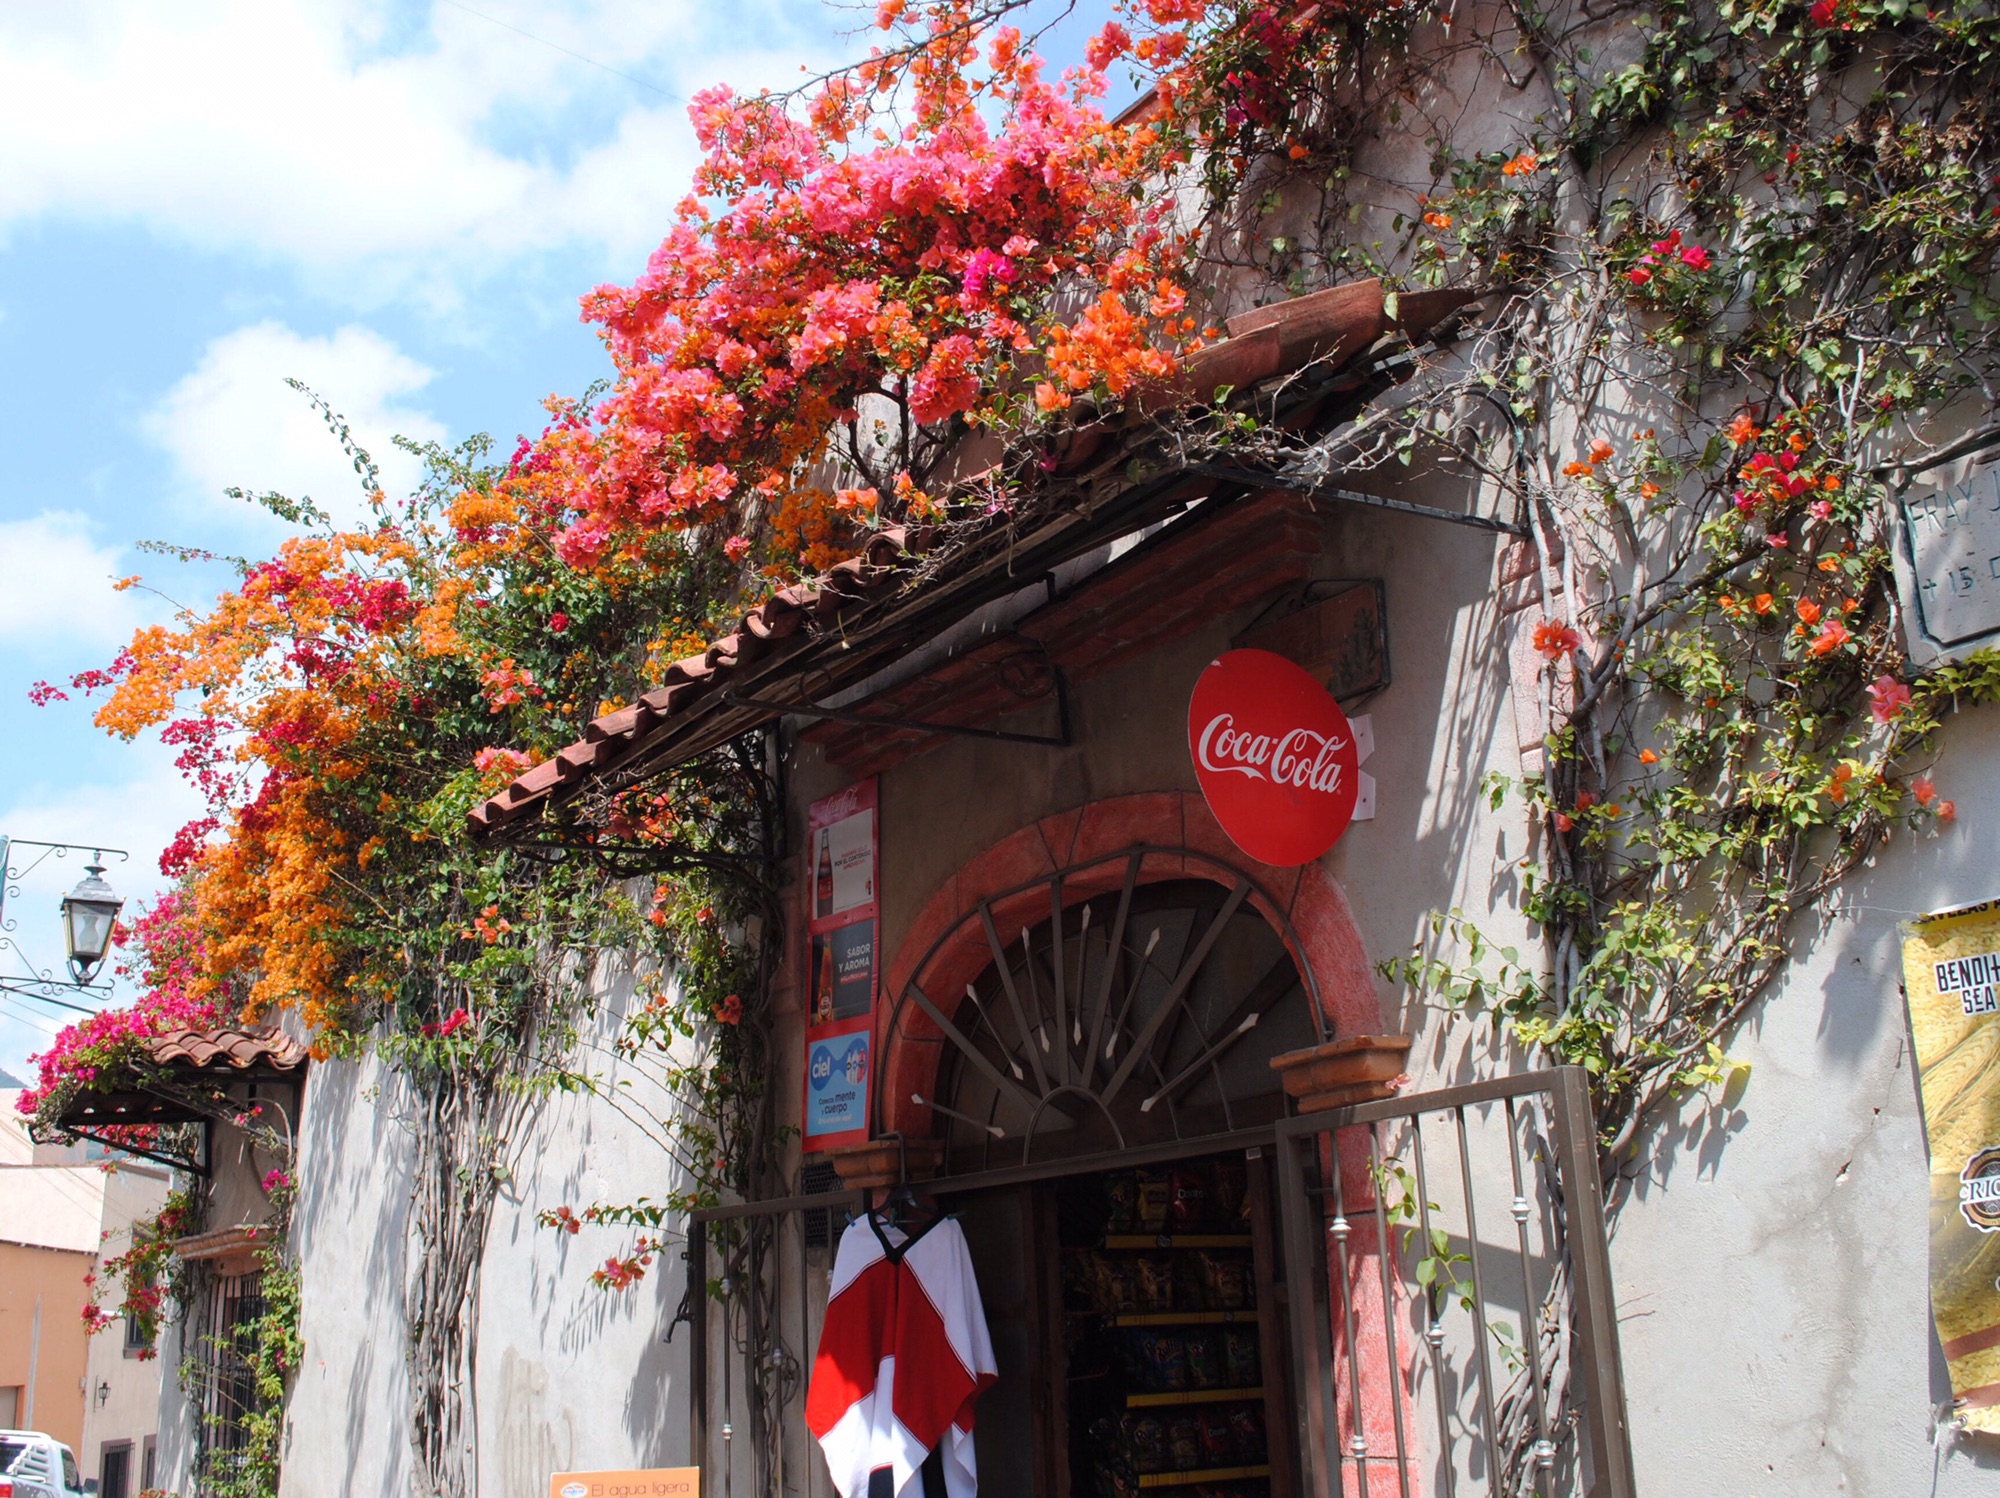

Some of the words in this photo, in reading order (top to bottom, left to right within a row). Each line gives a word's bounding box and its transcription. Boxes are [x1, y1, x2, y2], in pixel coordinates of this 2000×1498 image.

[1909, 479, 1972, 538] FRAY
[1198, 713, 1348, 794] Coca-Cola
[847, 943, 871, 958] SABOR
[838, 963, 844, 973] Y
[844, 956, 870, 972] AROMA
[812, 1056, 830, 1078] ciel
[835, 1090, 856, 1103] mente
[824, 1102, 848, 1115] cuerpo
[591, 1484, 603, 1497] El
[609, 1484, 646, 1498] agua
[652, 1481, 689, 1498] ligera
